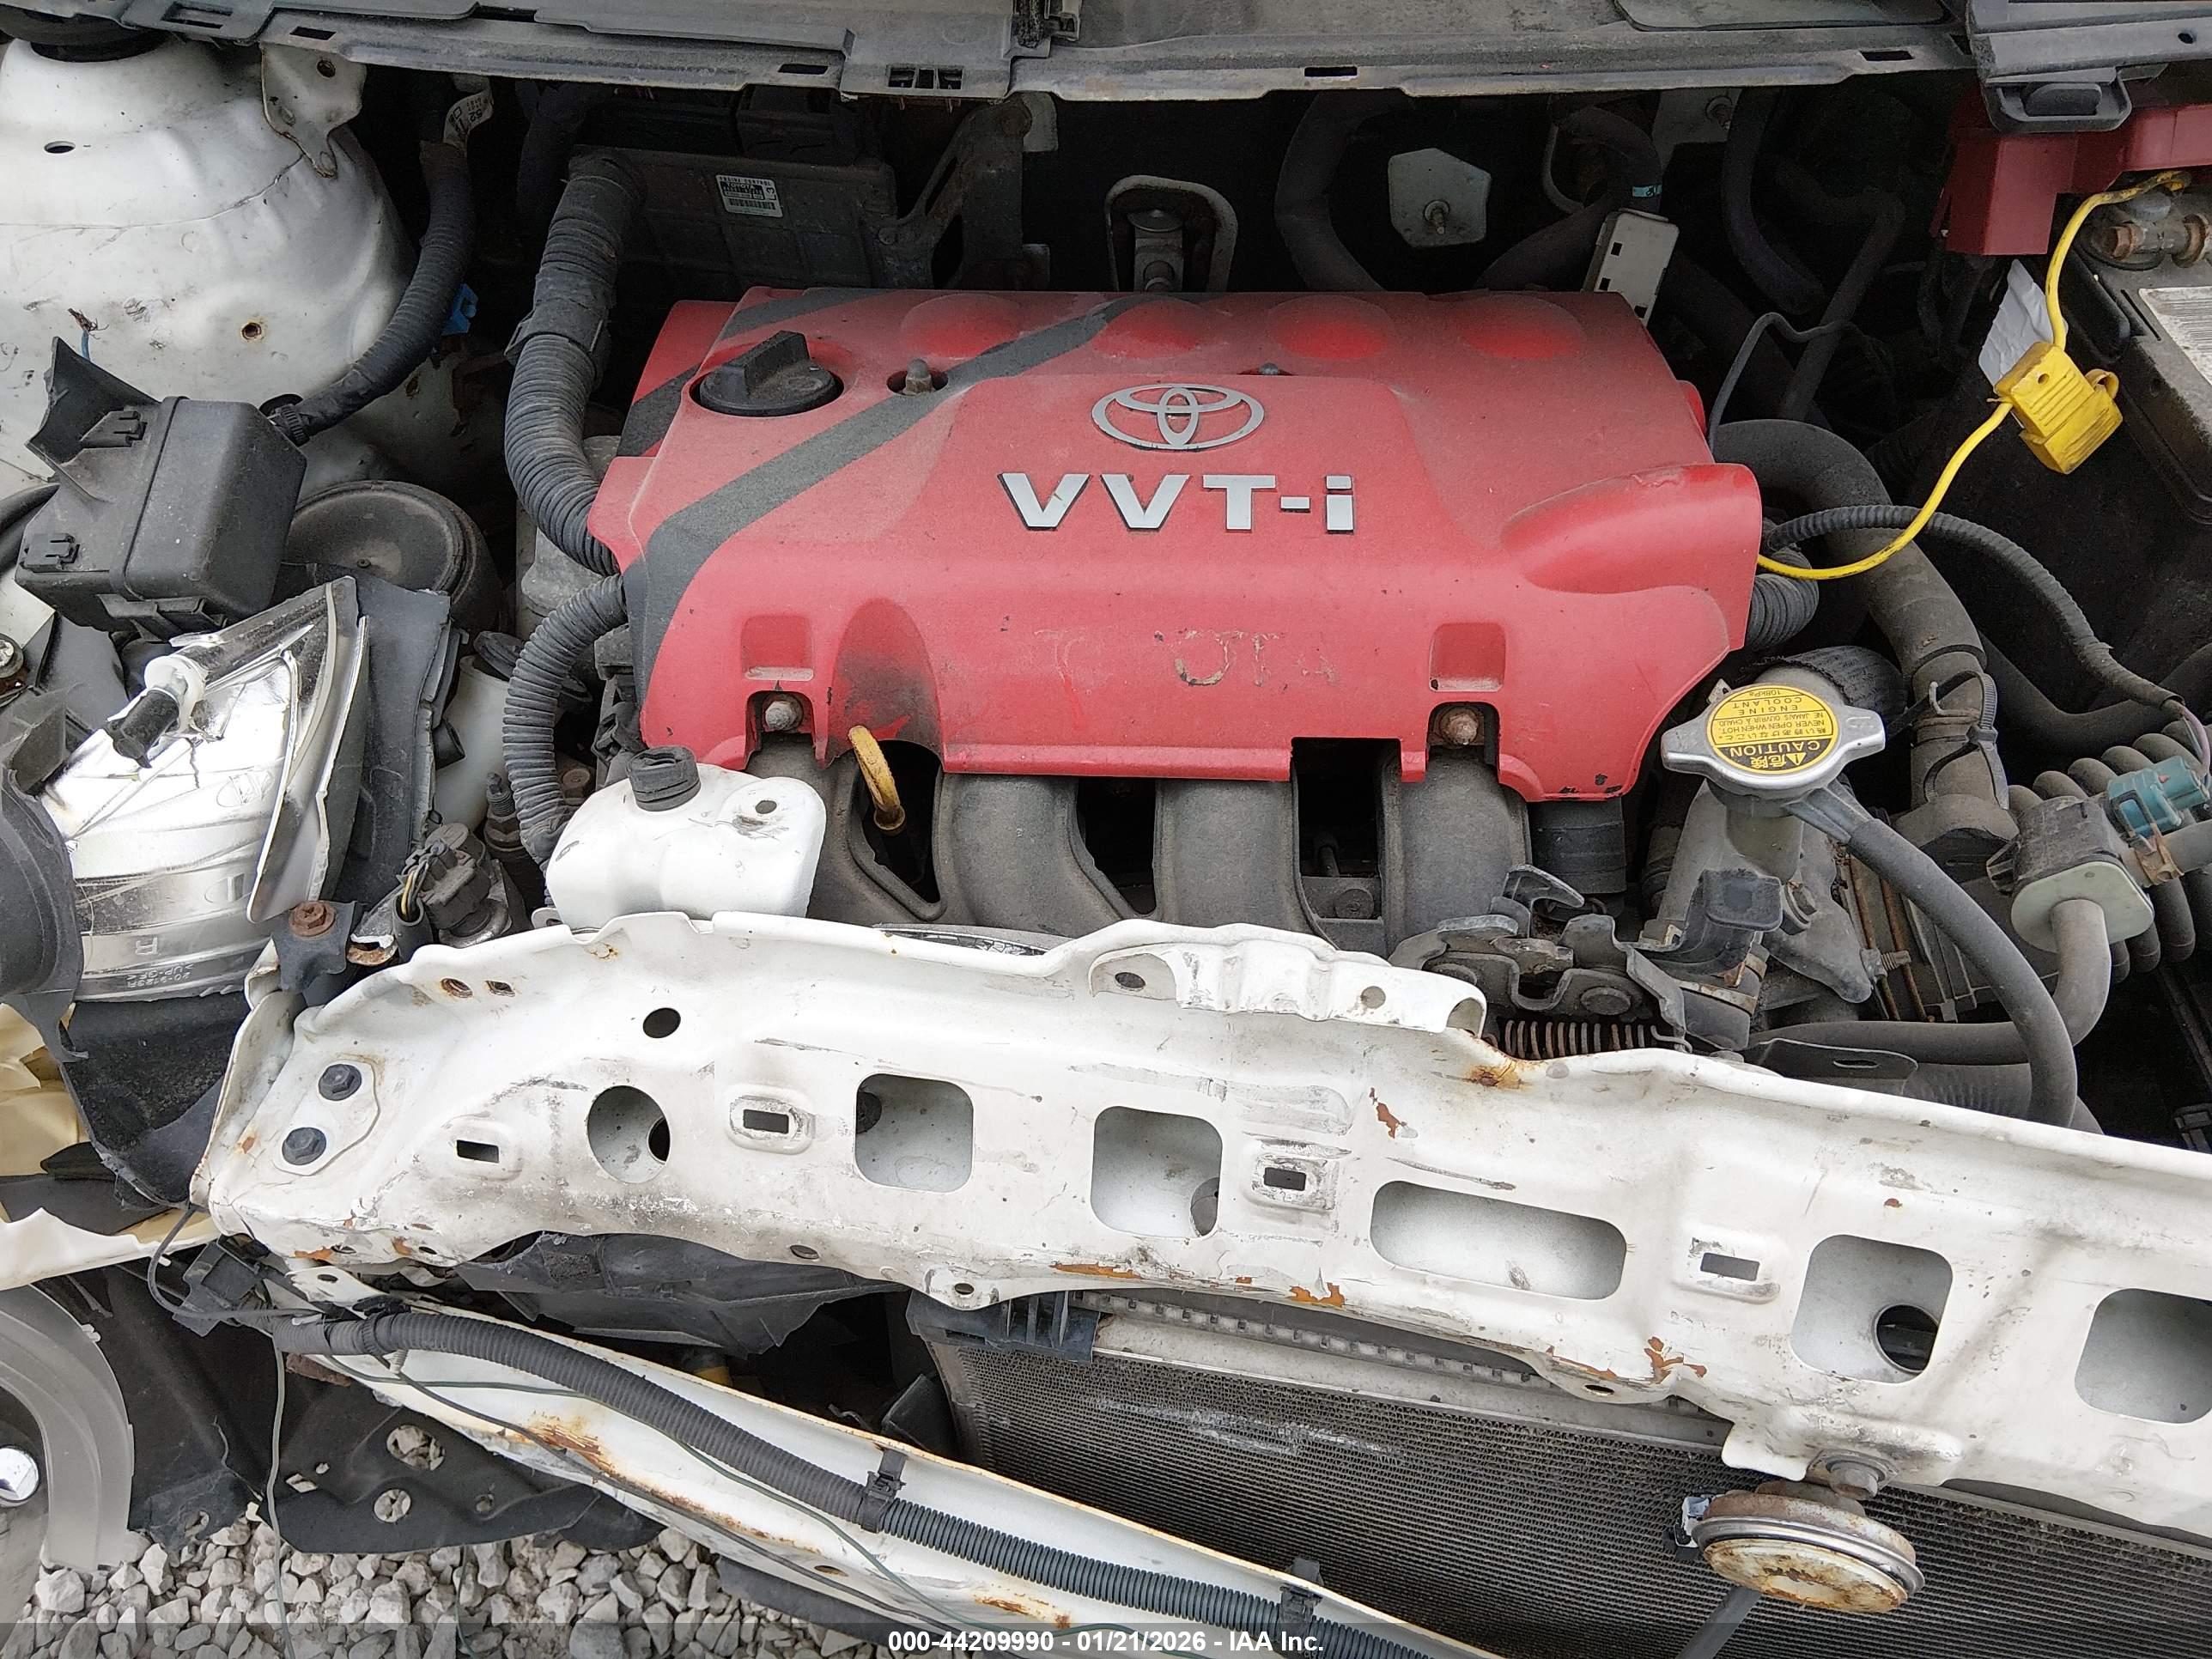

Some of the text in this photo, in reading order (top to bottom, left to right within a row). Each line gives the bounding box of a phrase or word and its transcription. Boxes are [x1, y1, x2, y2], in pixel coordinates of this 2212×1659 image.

[998, 473, 1354, 533] VVT-i
[1732, 696, 1802, 708] COOLANT
[1738, 704, 1798, 716] ENGINE
[1741, 723, 1767, 732] WHEN
[1729, 740, 1820, 757] CAUTION
[1750, 754, 1787, 769] 危険
